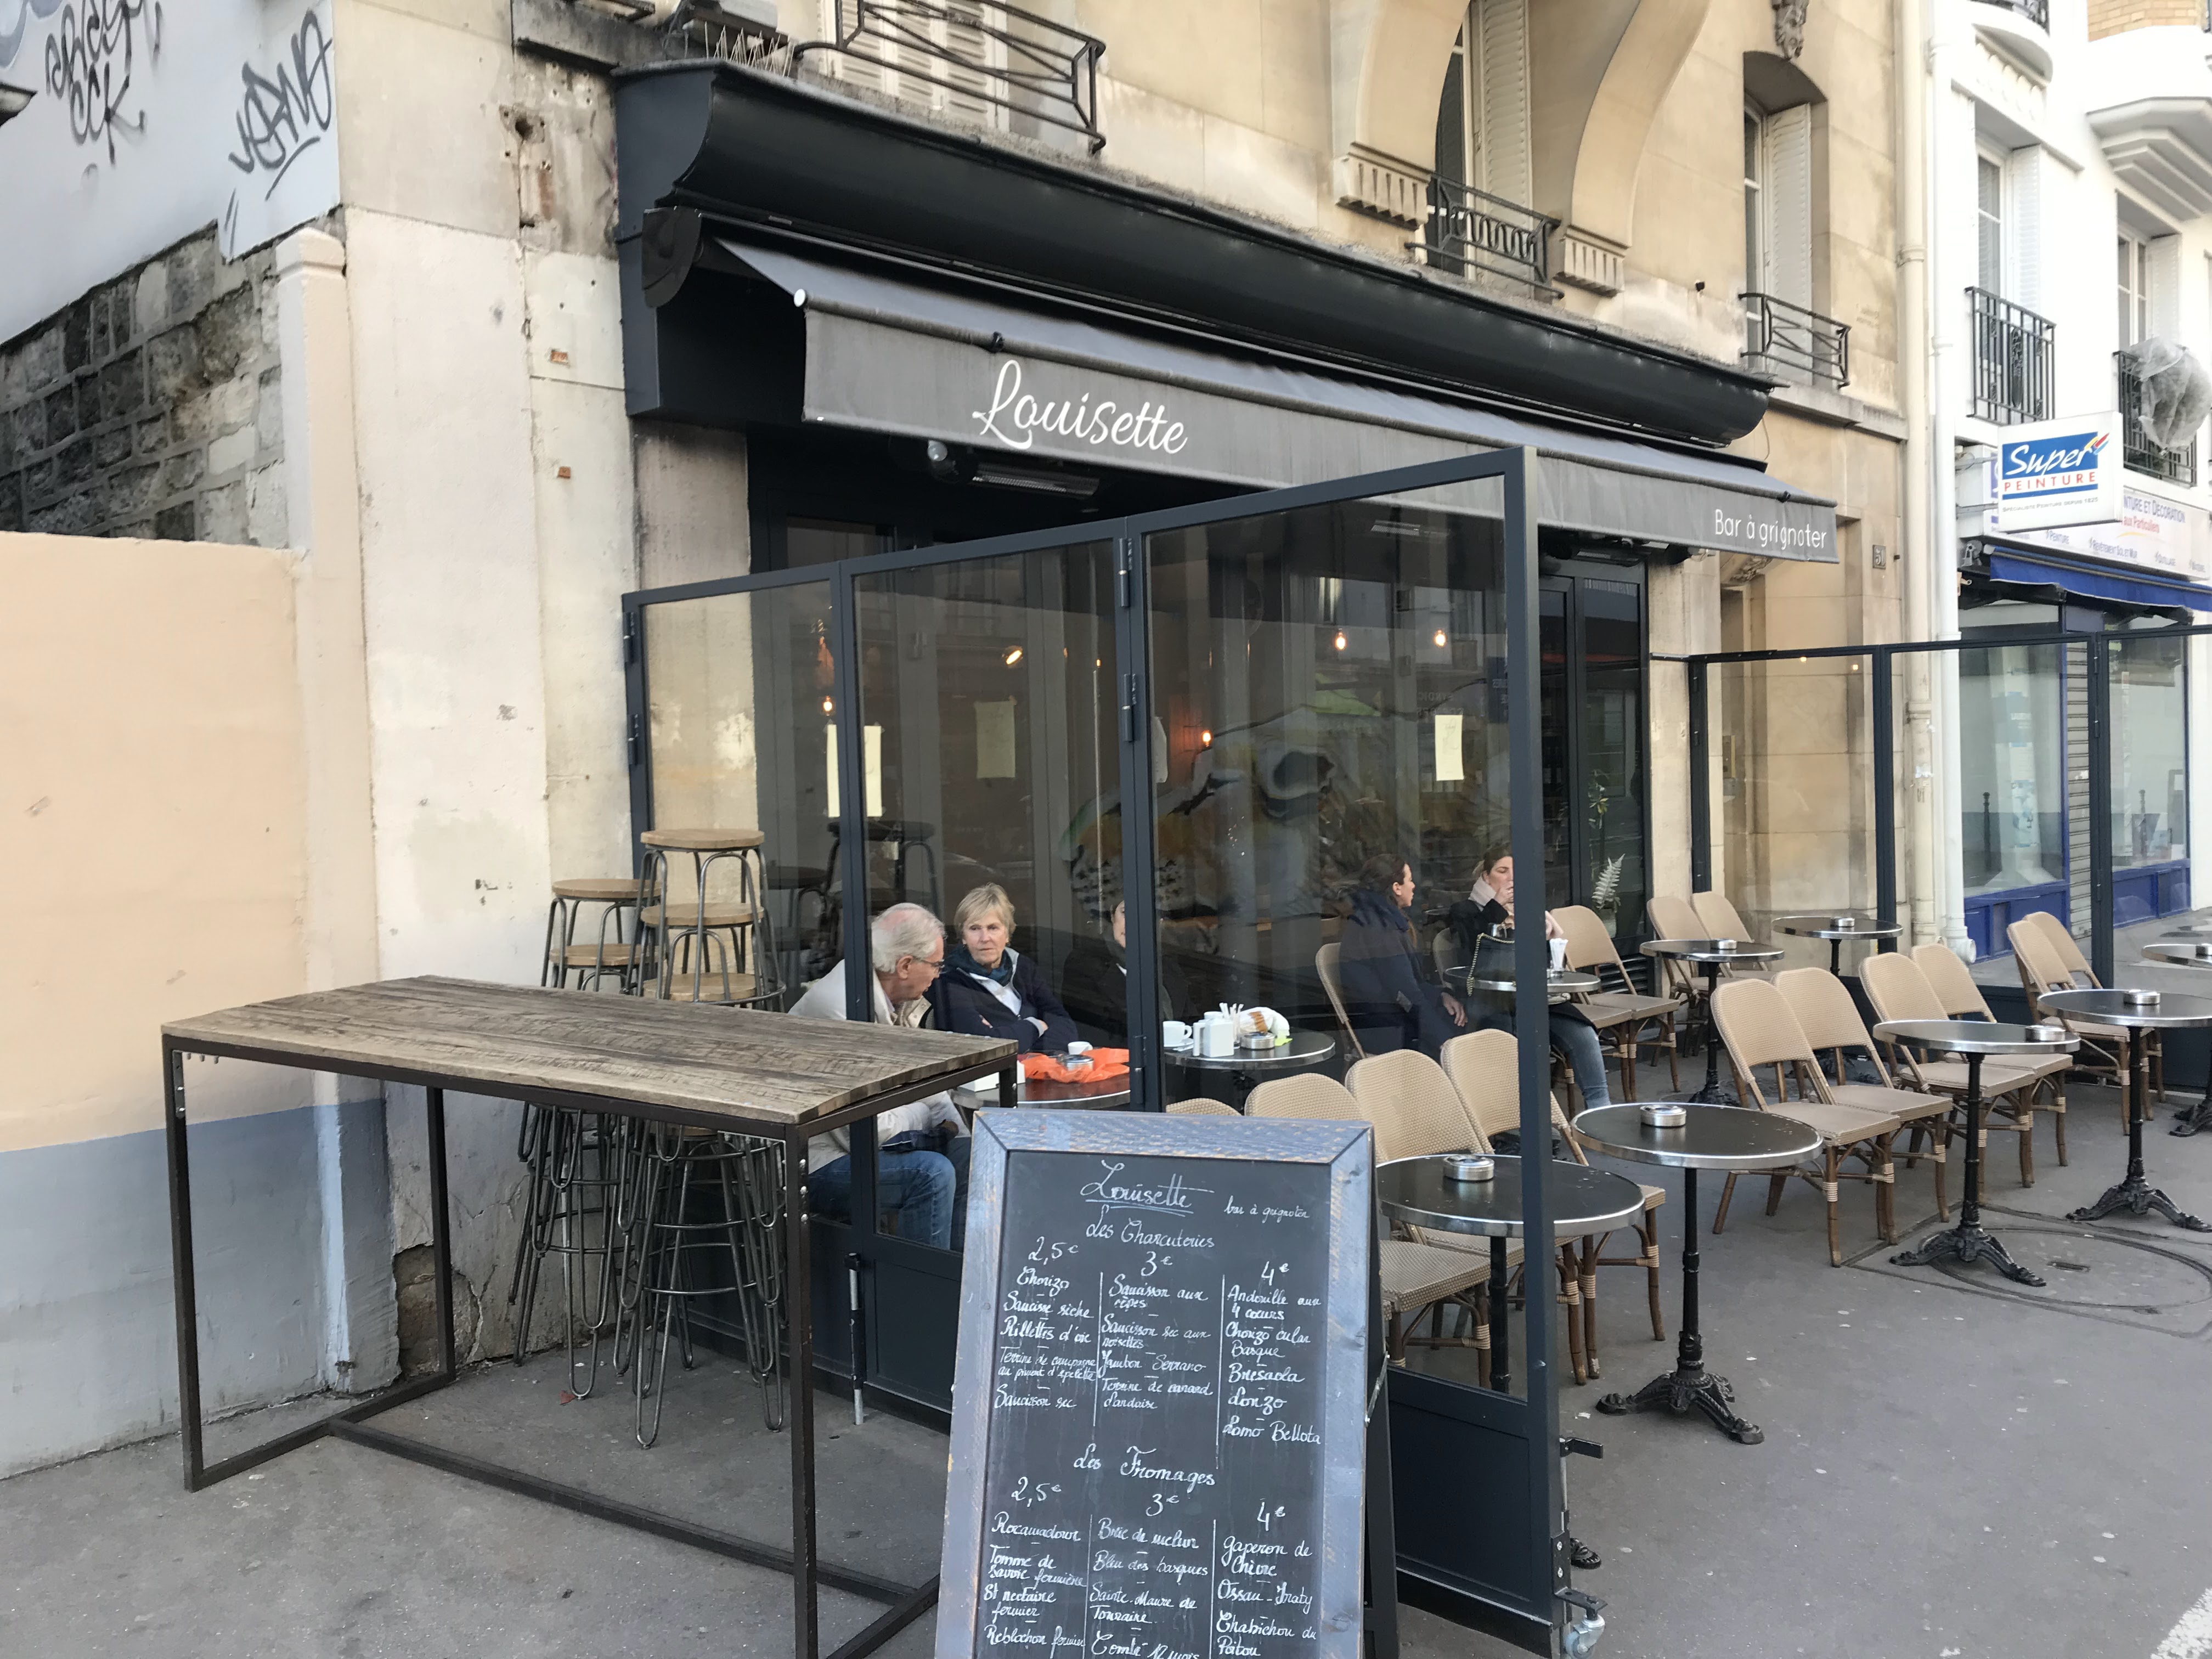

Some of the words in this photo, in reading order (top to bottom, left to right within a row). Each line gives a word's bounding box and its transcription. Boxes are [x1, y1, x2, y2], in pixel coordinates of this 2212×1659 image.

[972, 360, 1188, 454] Louisette
[2005, 444, 2093, 476] Super
[2004, 472, 2095, 492] PEINTURE
[1715, 509, 1741, 537] Bar
[1747, 514, 1755, 539] à
[1759, 521, 1827, 550] grignoter
[1080, 1160, 1214, 1207] Louisette
[1224, 1195, 1244, 1214] bar
[1250, 1204, 1258, 1215] à
[1262, 1205, 1310, 1223] grignoter
[1121, 1218, 1215, 1248] Charcuteries
[1017, 1266, 1070, 1297] Chorizo
[1109, 1274, 1170, 1297] Saucisson
[1177, 1289, 1209, 1301] aux
[1003, 1290, 1053, 1313] Saucisse
[1227, 1284, 1289, 1305] Andouille
[1232, 1303, 1240, 1318] 4
[1000, 1316, 1055, 1340] Rillettes
[1102, 1313, 1158, 1336] Saucisson
[1162, 1326, 1179, 1337] sec
[1183, 1330, 1211, 1339] aux
[1226, 1322, 1270, 1345] Chorizo
[1276, 1326, 1311, 1343] cular
[1102, 1335, 1144, 1348] noisettes
[1231, 1340, 1285, 1363] Basque
[1000, 1346, 1032, 1364] Terrine
[1035, 1354, 1048, 1365] de
[1052, 1356, 1096, 1369] campagne
[1098, 1350, 1142, 1379] Jambon
[1152, 1354, 1206, 1372] Serrano
[998, 1366, 1012, 1376] au
[1014, 1367, 1045, 1381] piment
[1228, 1363, 1305, 1383] Bresaola
[994, 1384, 1051, 1409] Saucisson
[1056, 1397, 1077, 1409] sec
[1102, 1378, 1142, 1392] Terrine
[1148, 1381, 1163, 1392] de
[1167, 1383, 1214, 1396] canard
[1228, 1386, 1287, 1415] Lonzo
[1222, 1415, 1265, 1437] Lomo
[1269, 1421, 1321, 1444] Bellota
[1120, 1446, 1215, 1493] Fromages
[991, 1511, 1081, 1542] Rocamadour
[1098, 1517, 1128, 1540] Brie
[1132, 1527, 1148, 1543] de
[1294, 1540, 1312, 1557] de
[1038, 1554, 1057, 1569] de
[1093, 1550, 1124, 1571] Bleu
[1128, 1560, 1149, 1571] des
[1156, 1556, 1208, 1583] basques
[984, 1583, 998, 1600] St
[1180, 1598, 1197, 1609] de
[992, 1601, 1040, 1624] fermier
[1090, 1605, 1153, 1623] Touraine
[984, 1624, 1047, 1645] Reblochon
[1216, 1610, 1294, 1637] Chabichou
[1302, 1627, 1316, 1640] du
[1091, 1631, 1148, 1656] Comté
[1217, 1635, 1261, 1656] Poitou
